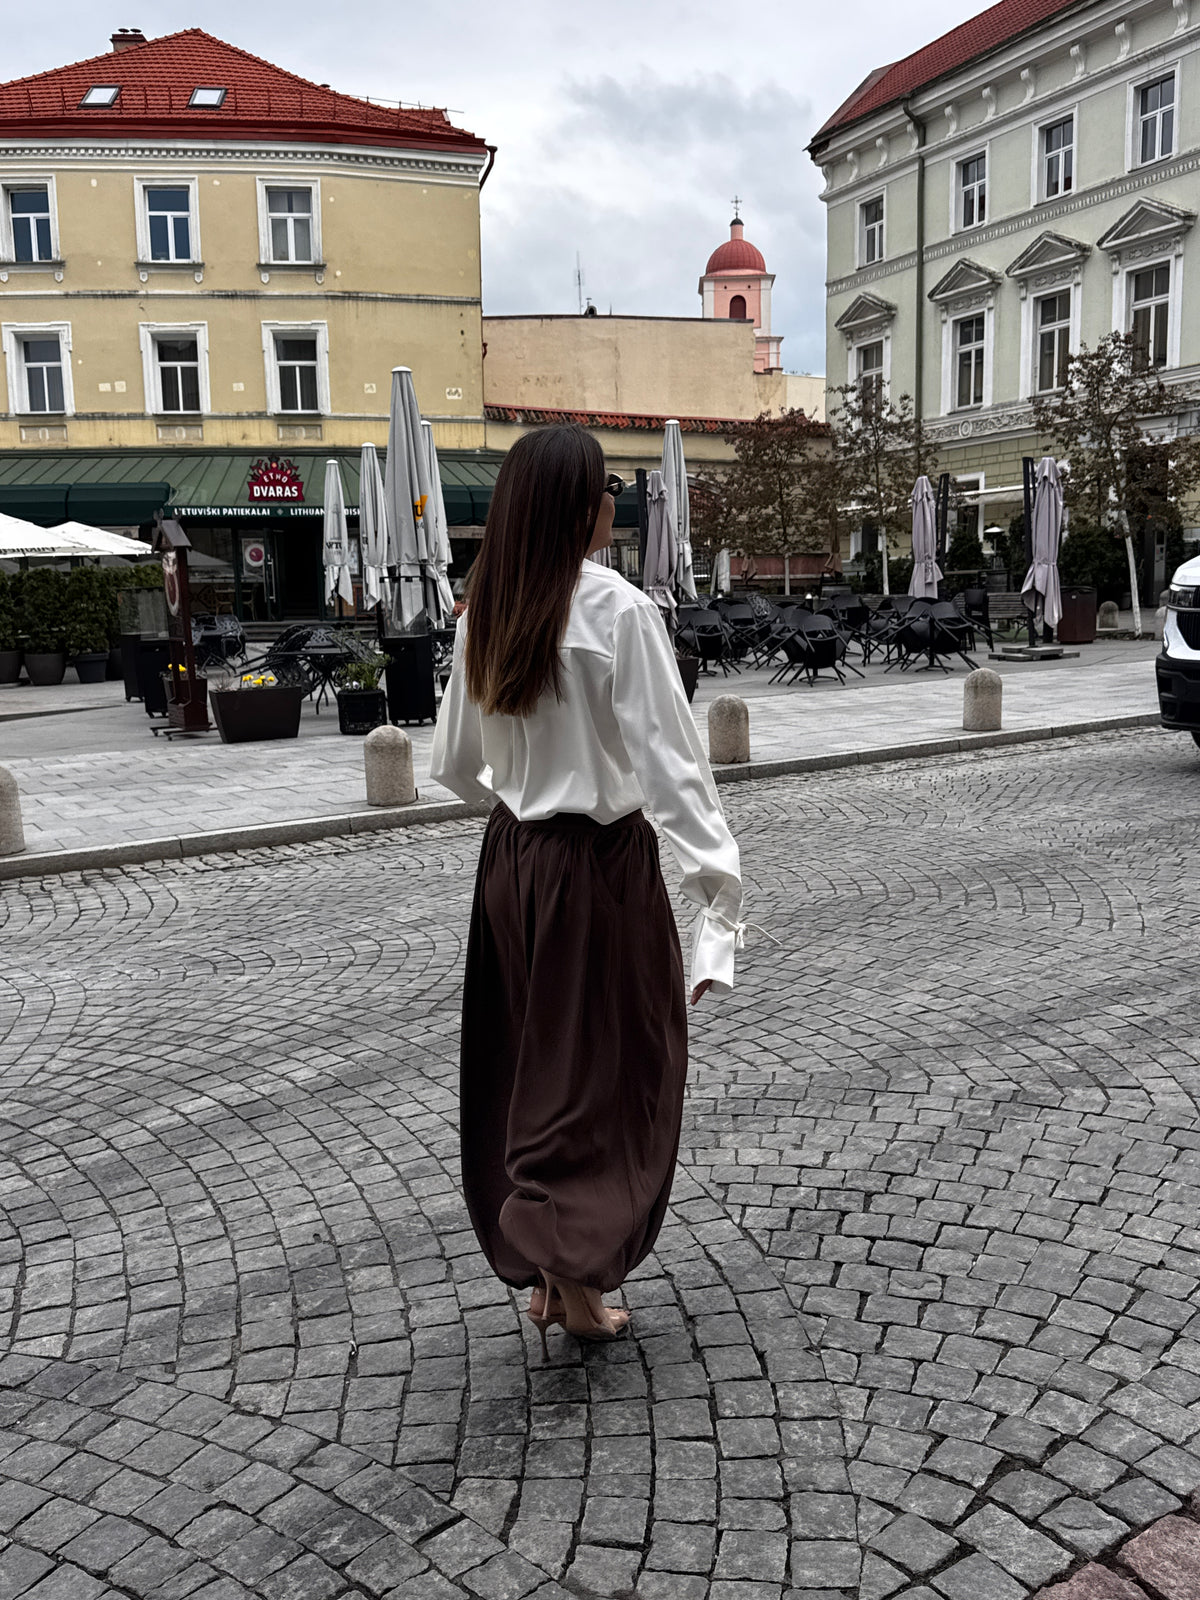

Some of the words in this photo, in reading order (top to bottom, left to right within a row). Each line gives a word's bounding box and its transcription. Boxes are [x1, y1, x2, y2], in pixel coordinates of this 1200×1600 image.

[253, 485, 299, 497] DVARAS
[174, 506, 221, 516] LETUVIŠKI
[223, 507, 270, 516] PATIEKALAI
